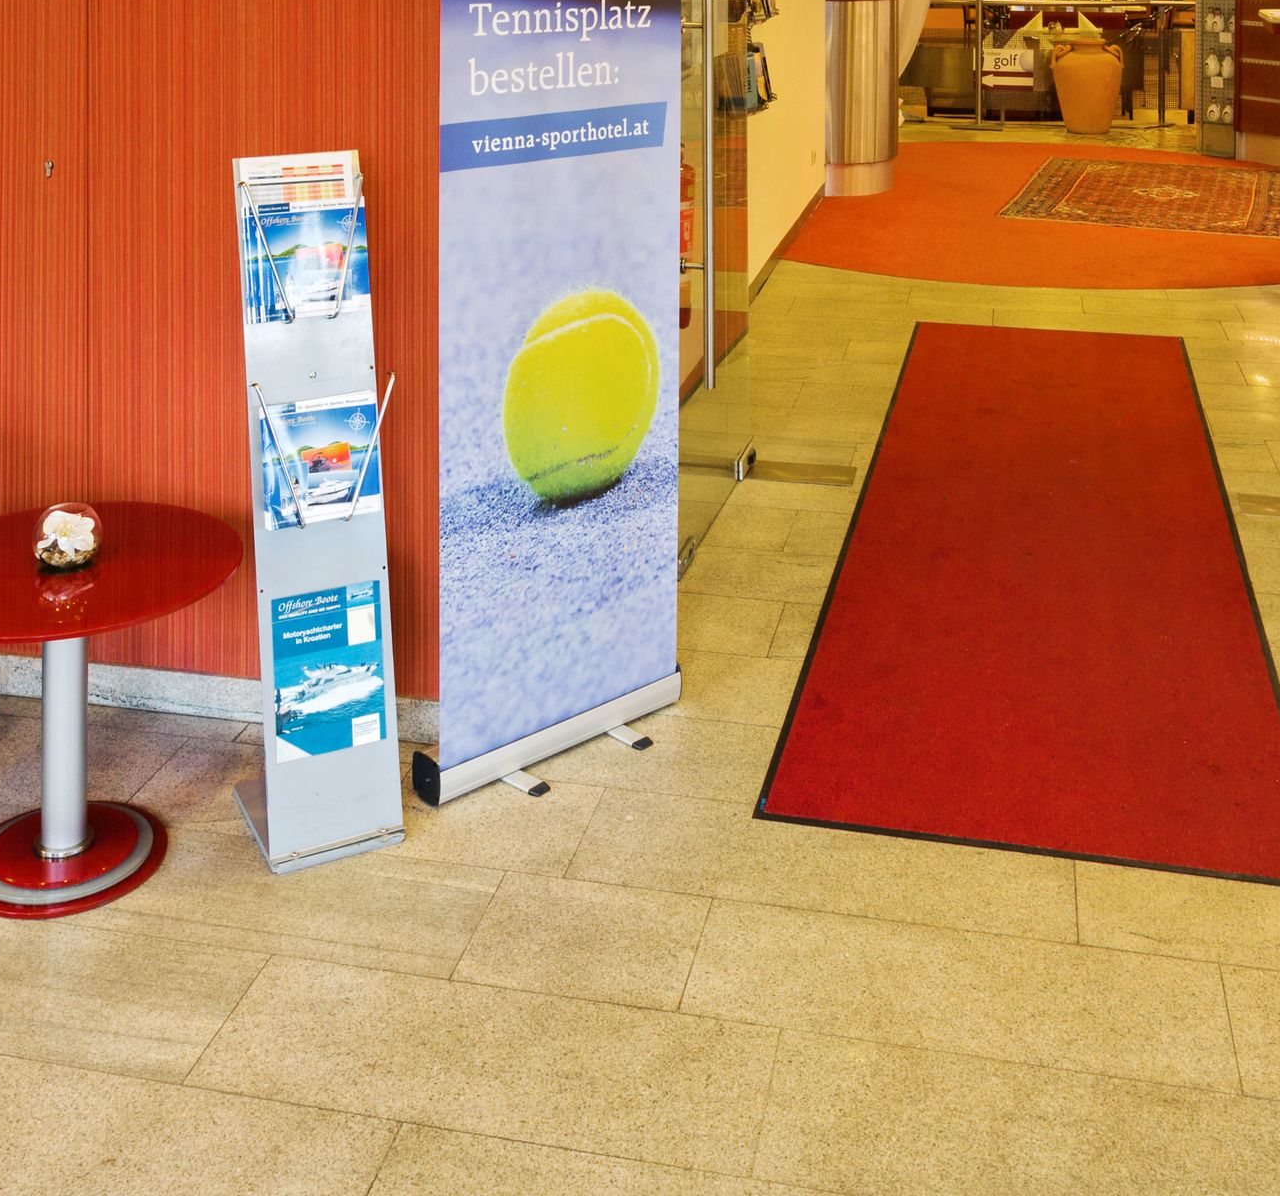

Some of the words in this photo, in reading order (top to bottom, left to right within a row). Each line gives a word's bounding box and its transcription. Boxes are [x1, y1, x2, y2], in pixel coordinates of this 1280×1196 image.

[993, 53, 1018, 70] golf
[468, 52, 620, 96] bestellen:
[472, 118, 649, 154] vienna-sporthotel.at
[278, 598, 313, 615] Offshore
[314, 594, 339, 605] Boote
[283, 622, 343, 640] Motoryachtcharter
[295, 637, 302, 645] in
[303, 633, 331, 644] Kroatien
